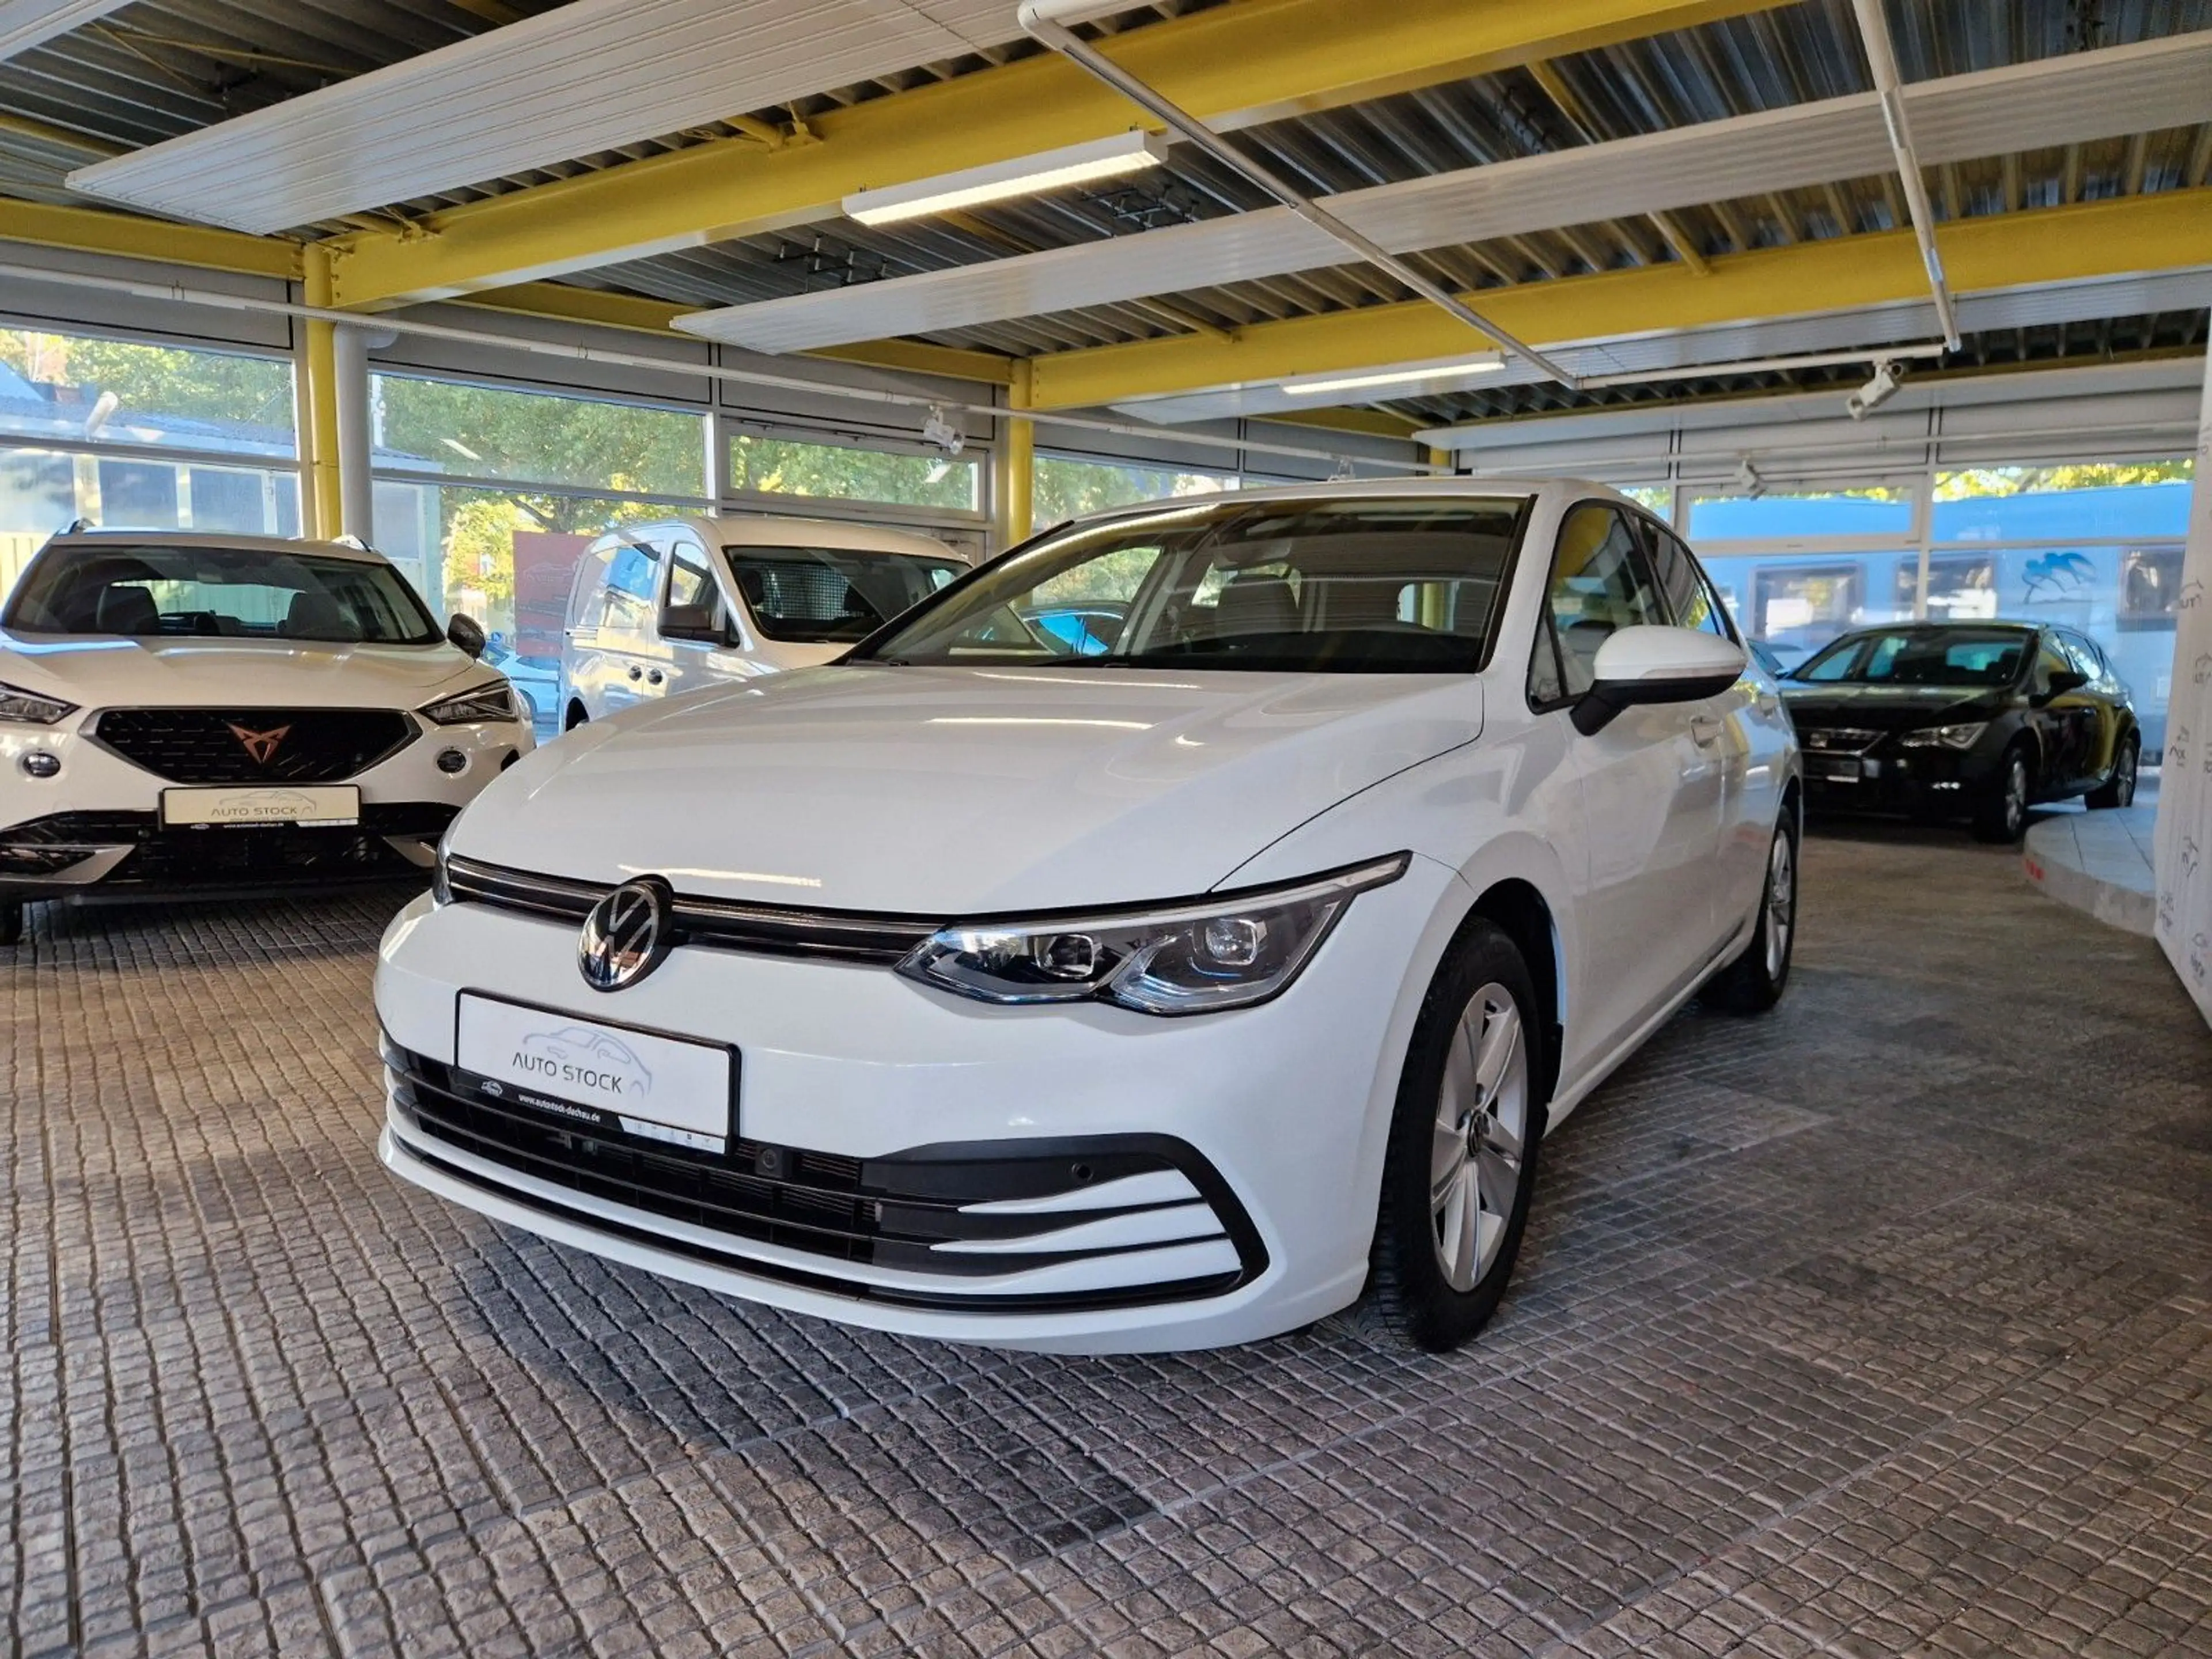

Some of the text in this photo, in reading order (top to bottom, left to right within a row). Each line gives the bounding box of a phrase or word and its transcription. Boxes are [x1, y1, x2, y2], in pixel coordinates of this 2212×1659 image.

[211, 806, 297, 817] AUTO STOCK
[512, 1051, 622, 1094] AUTO STOCK
